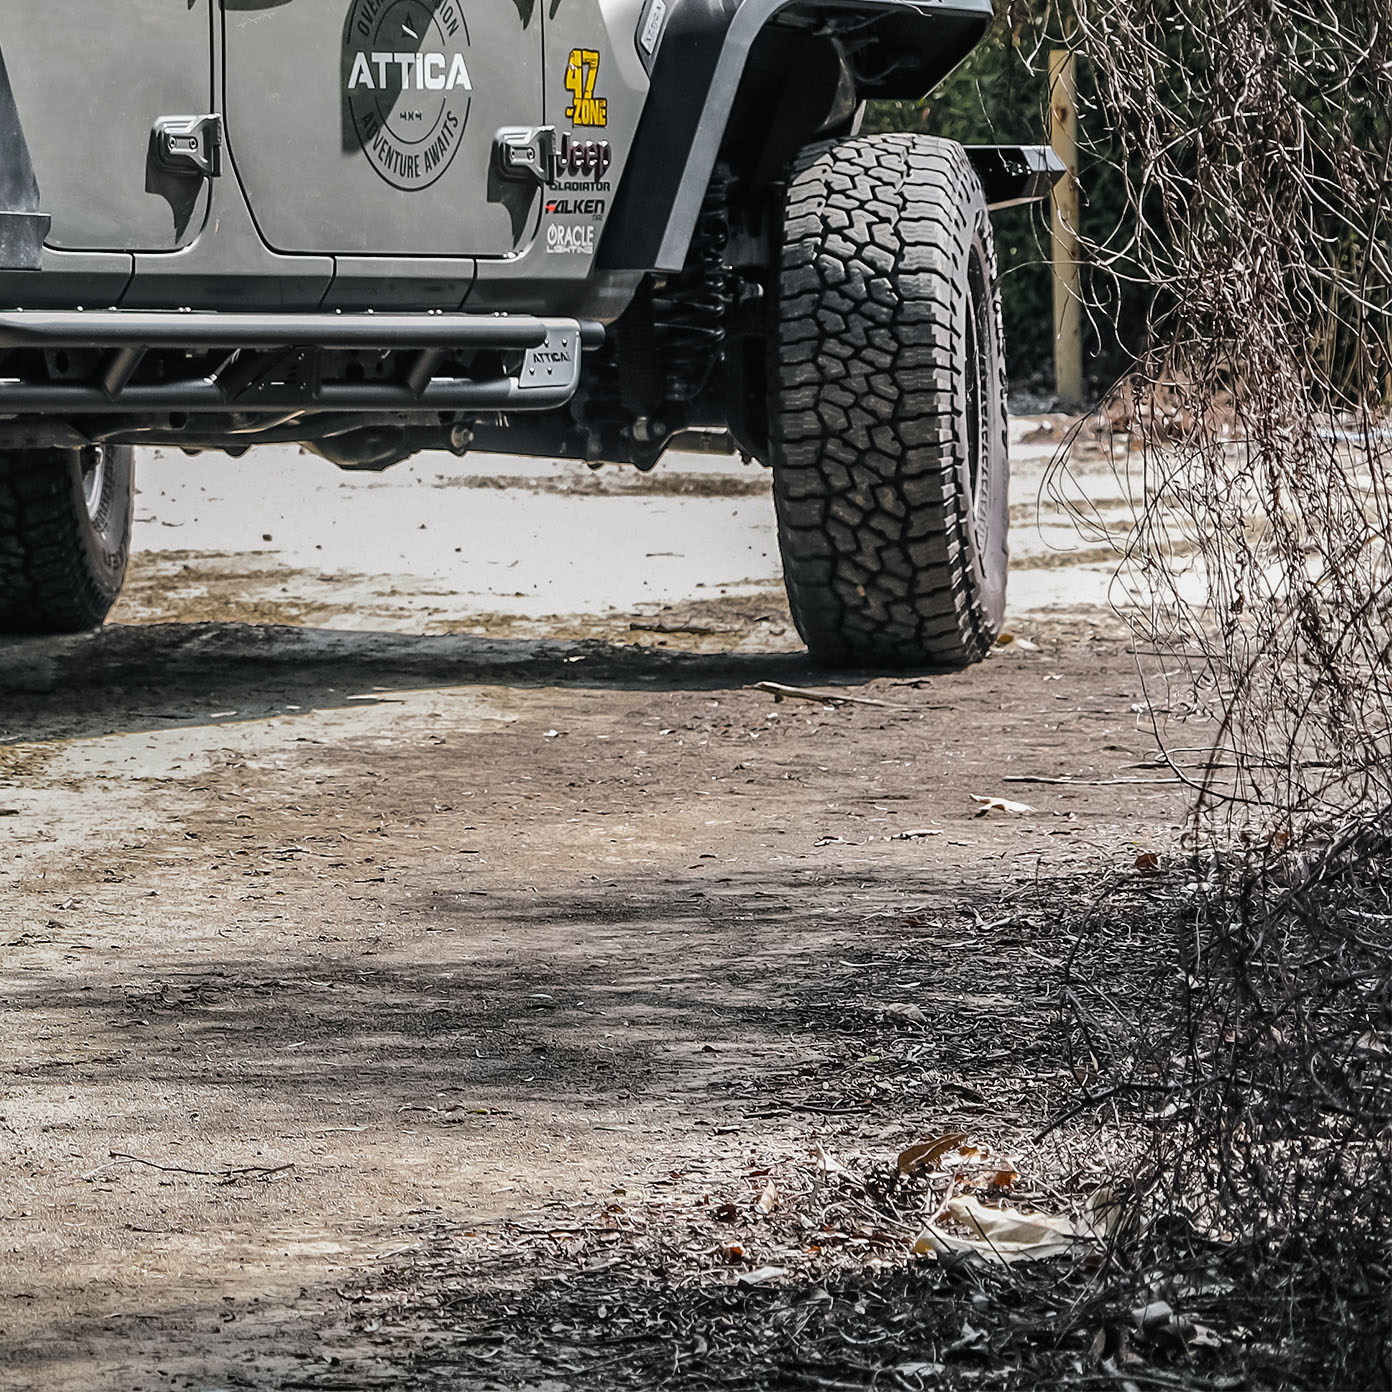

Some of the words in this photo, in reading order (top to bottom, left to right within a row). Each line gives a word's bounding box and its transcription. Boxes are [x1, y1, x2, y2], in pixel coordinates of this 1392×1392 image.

[347, 51, 473, 90] ATTICA
[565, 49, 600, 99] 47
[362, 111, 421, 178] ADVENTURE
[424, 110, 459, 175] AWAITS
[556, 131, 611, 183] Jeep
[549, 182, 610, 191] GLADIATOR
[545, 199, 605, 214] FALKEN
[547, 224, 594, 246] ORACLE
[533, 351, 569, 363] ATTICA
